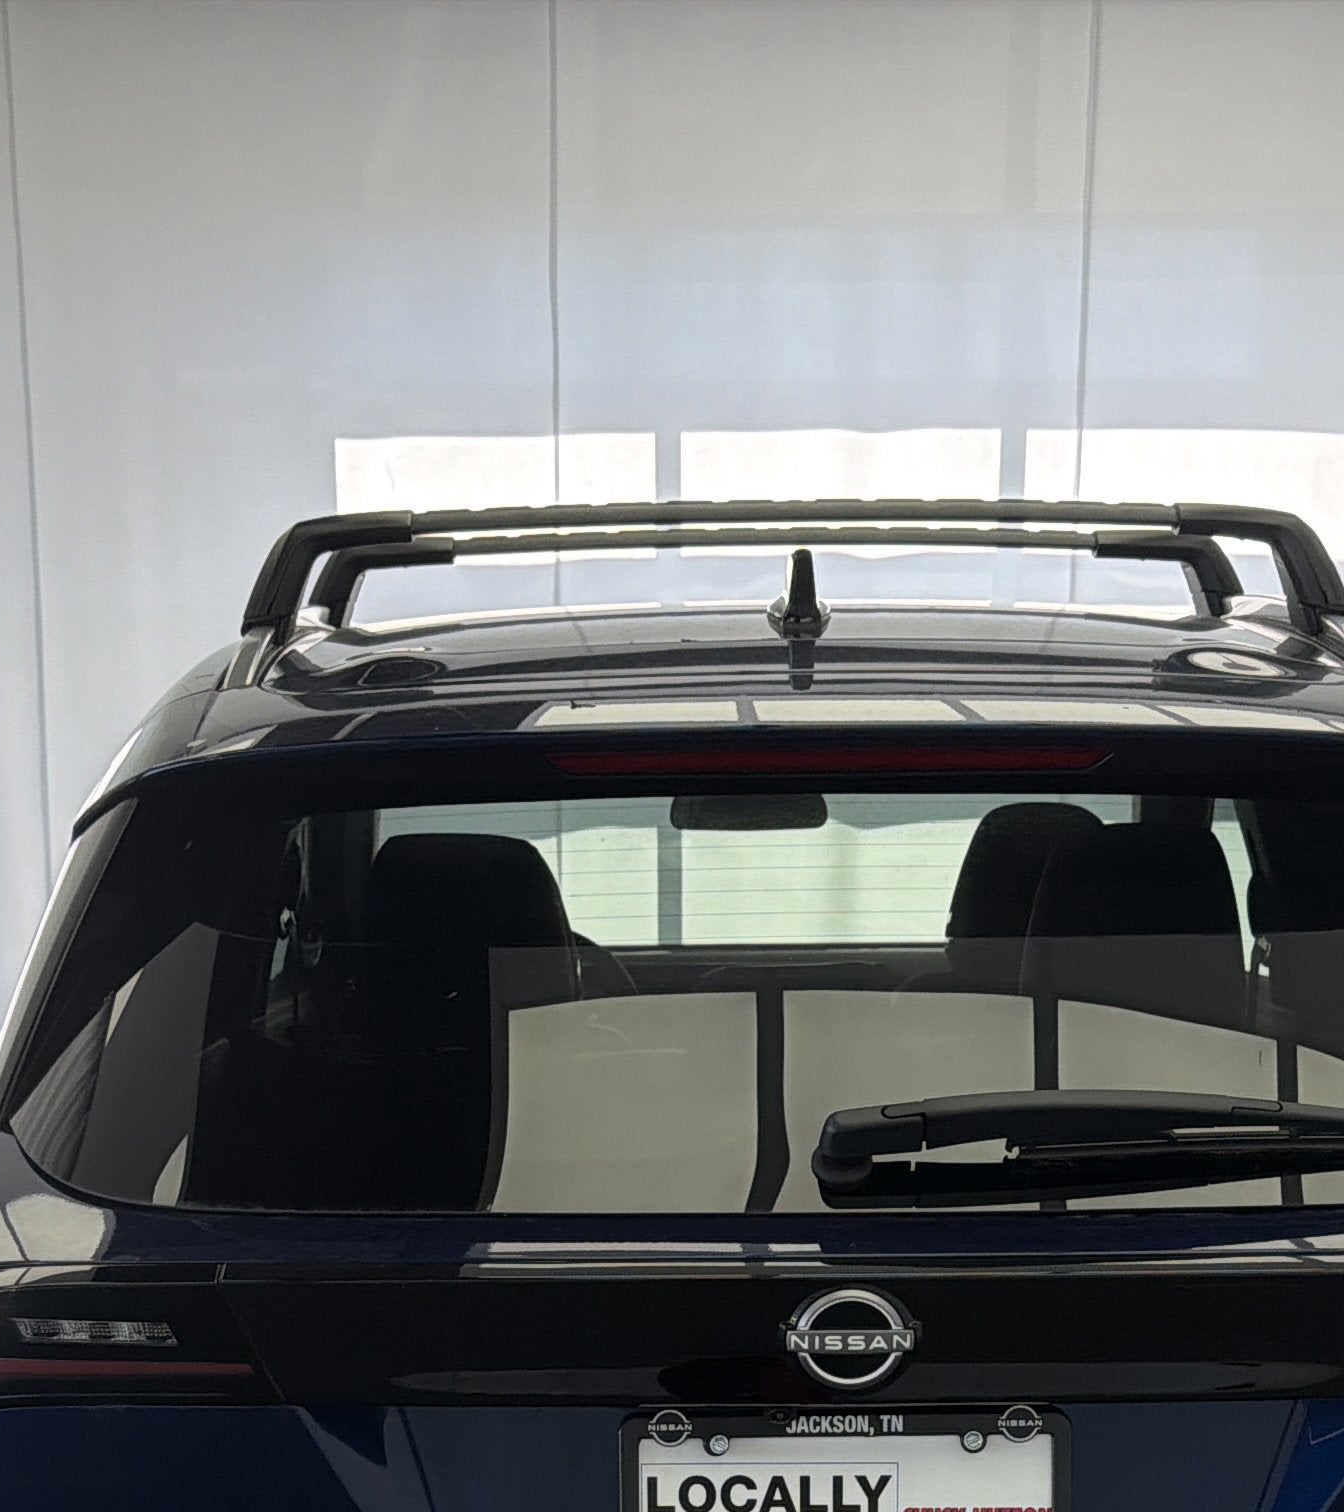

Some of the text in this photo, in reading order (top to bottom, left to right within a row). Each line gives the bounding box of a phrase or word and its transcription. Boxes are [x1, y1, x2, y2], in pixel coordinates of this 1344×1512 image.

[790, 1334, 911, 1351] NISSAN
[648, 1424, 693, 1432] NISSAN
[786, 1415, 904, 1435] JACKSON, TN
[998, 1420, 1042, 1428] NISSAN
